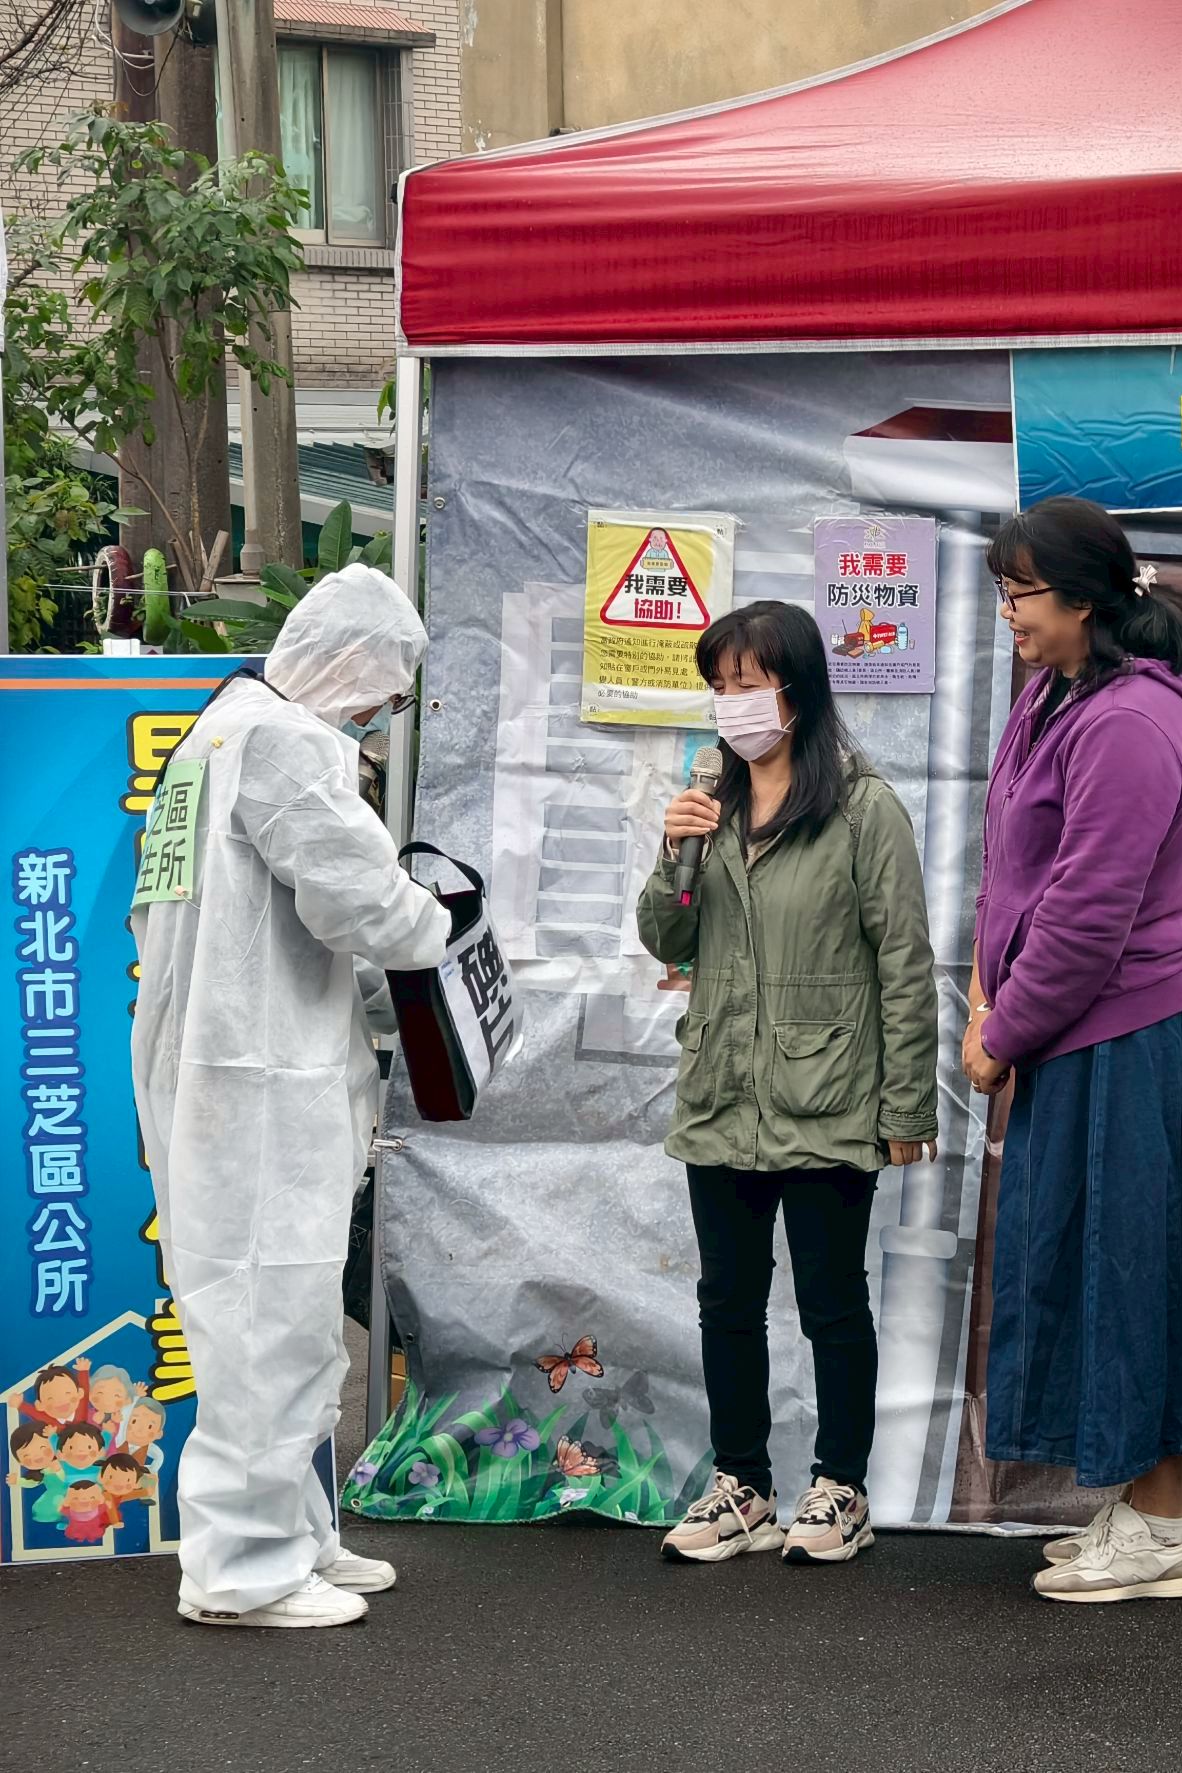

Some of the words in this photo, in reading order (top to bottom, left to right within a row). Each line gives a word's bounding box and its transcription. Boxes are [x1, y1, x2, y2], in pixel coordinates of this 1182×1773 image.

[838, 553, 908, 577] 我需要
[624, 573, 689, 598] 我需要
[827, 583, 920, 608] 防災物資
[17, 852, 88, 1314] 新北市三芝區公所
